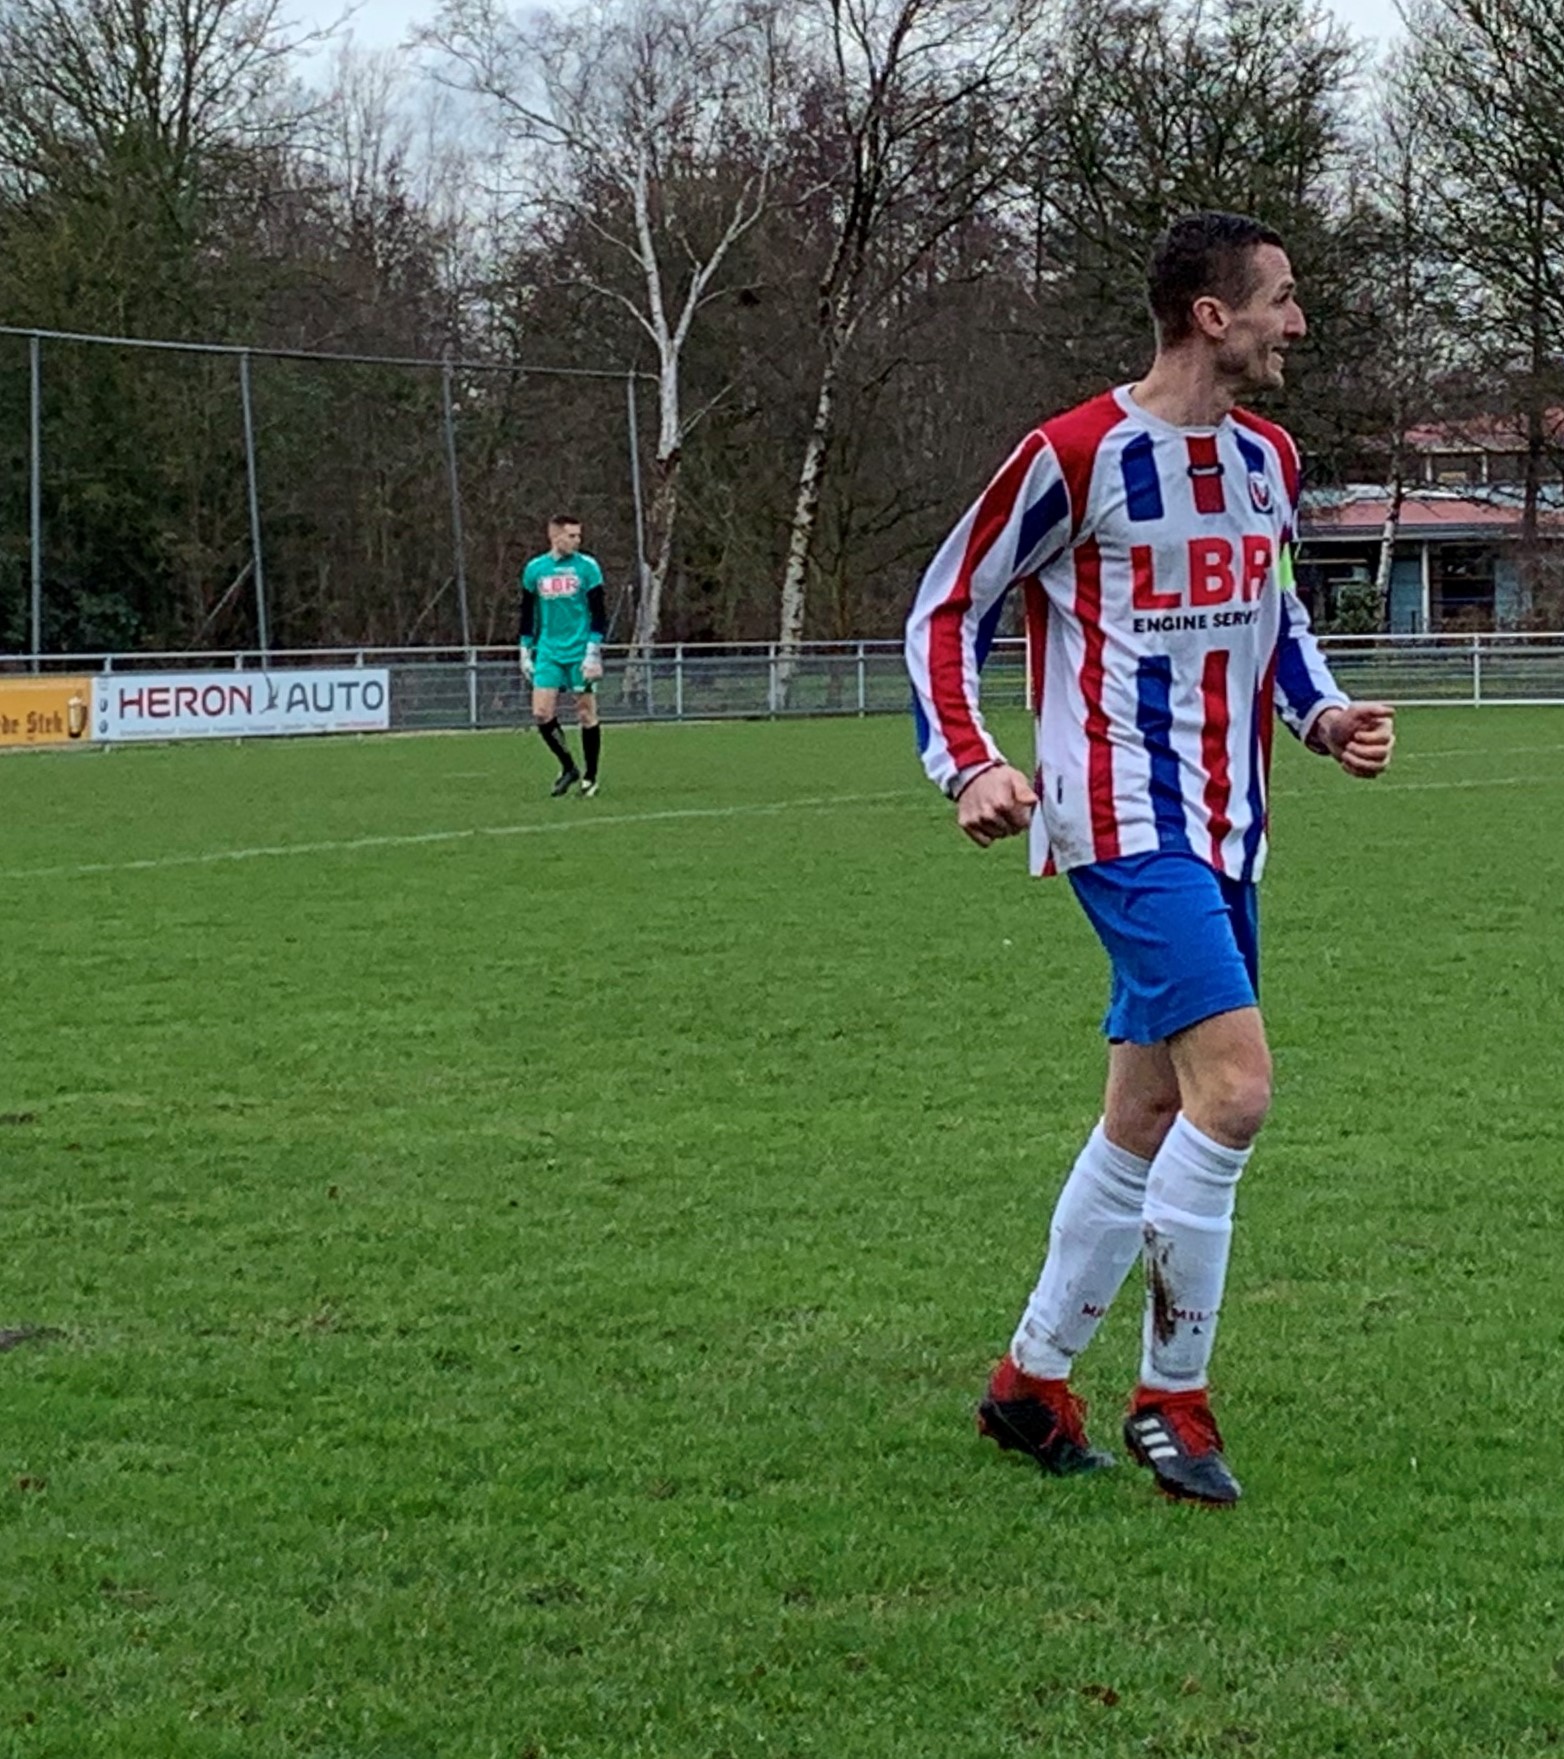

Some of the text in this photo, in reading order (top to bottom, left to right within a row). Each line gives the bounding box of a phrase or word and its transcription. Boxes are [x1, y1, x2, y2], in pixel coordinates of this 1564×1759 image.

[539, 577, 580, 593] LBR
[1133, 615, 1207, 633] ENGINE
[118, 680, 384, 719] HERON AUTO
